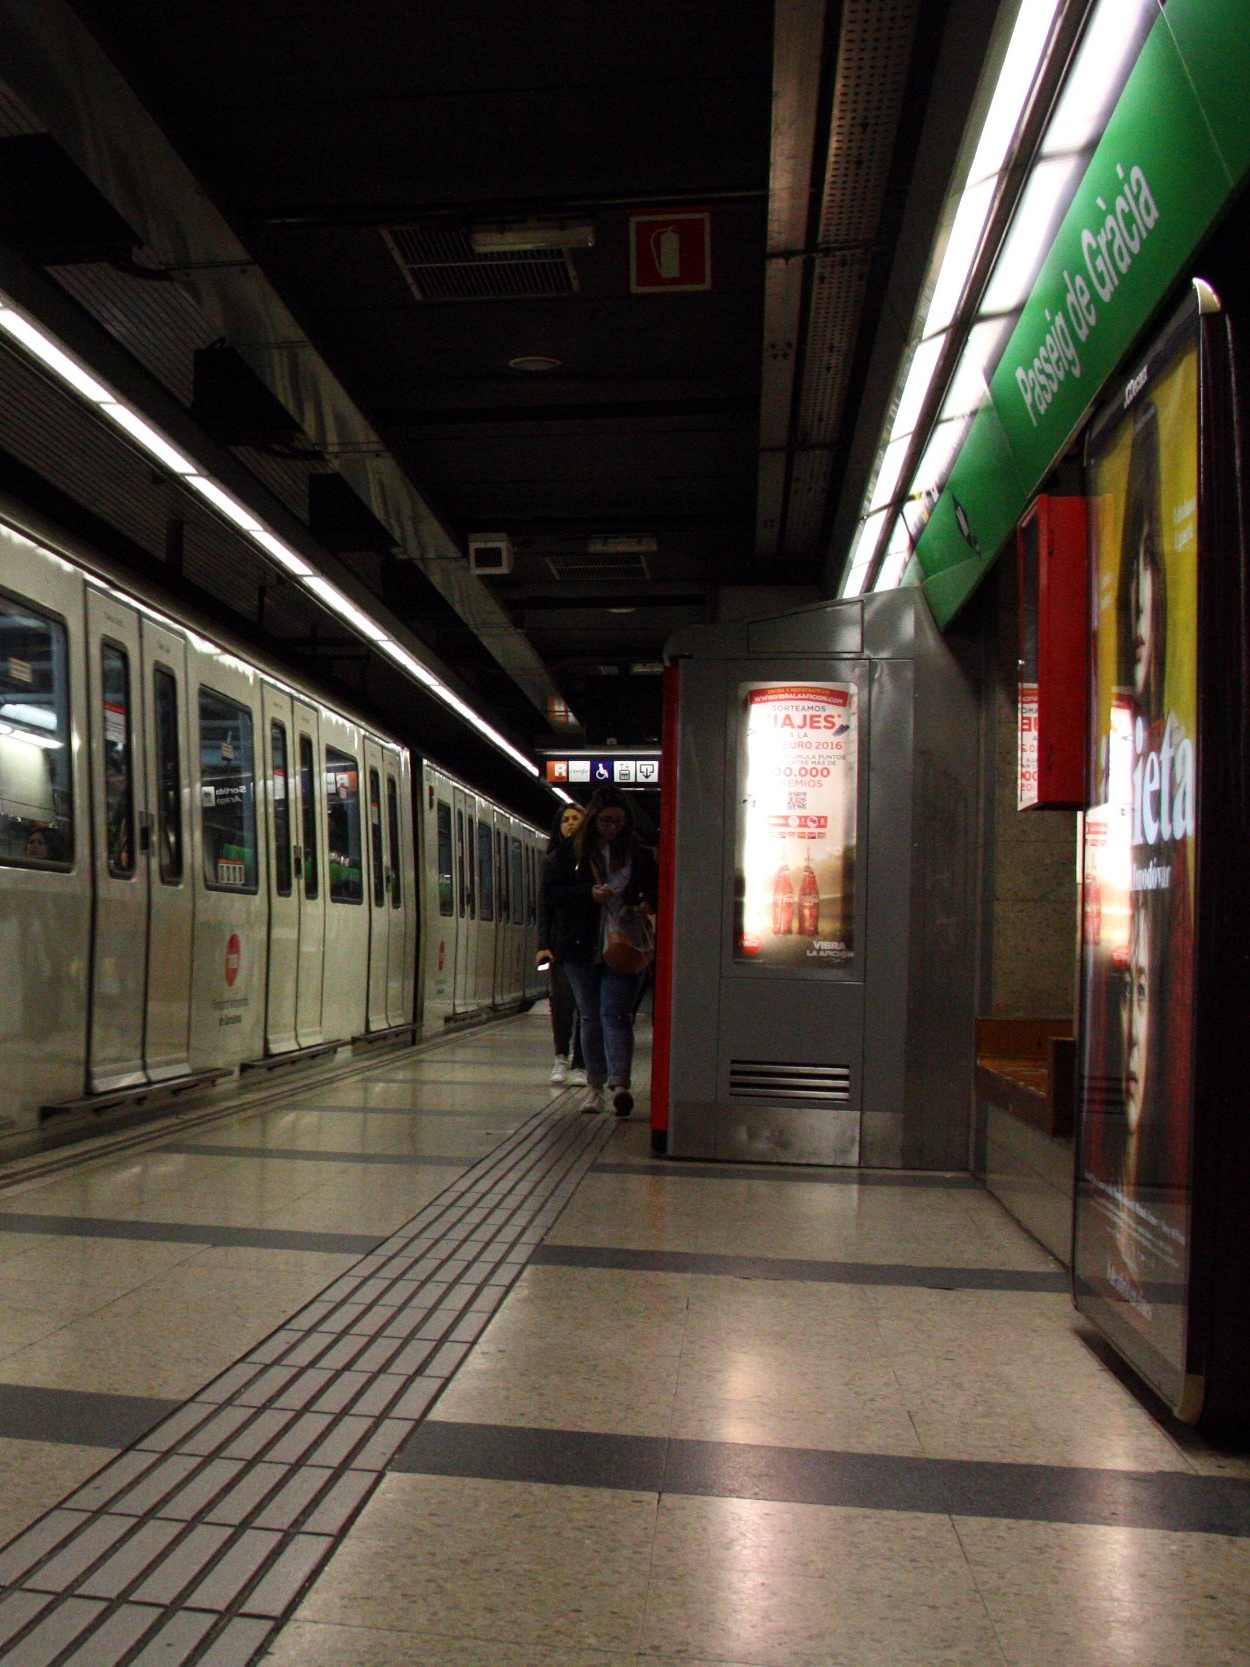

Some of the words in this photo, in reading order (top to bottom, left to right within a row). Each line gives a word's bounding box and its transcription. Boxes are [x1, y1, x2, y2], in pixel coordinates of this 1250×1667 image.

[1015, 308, 1081, 427] Passeig
[1063, 269, 1097, 343] de
[1081, 163, 1160, 303] Gràcia
[815, 741, 843, 750] 2016
[772, 766, 830, 778] 00.000
[813, 940, 846, 950] VIBRA
